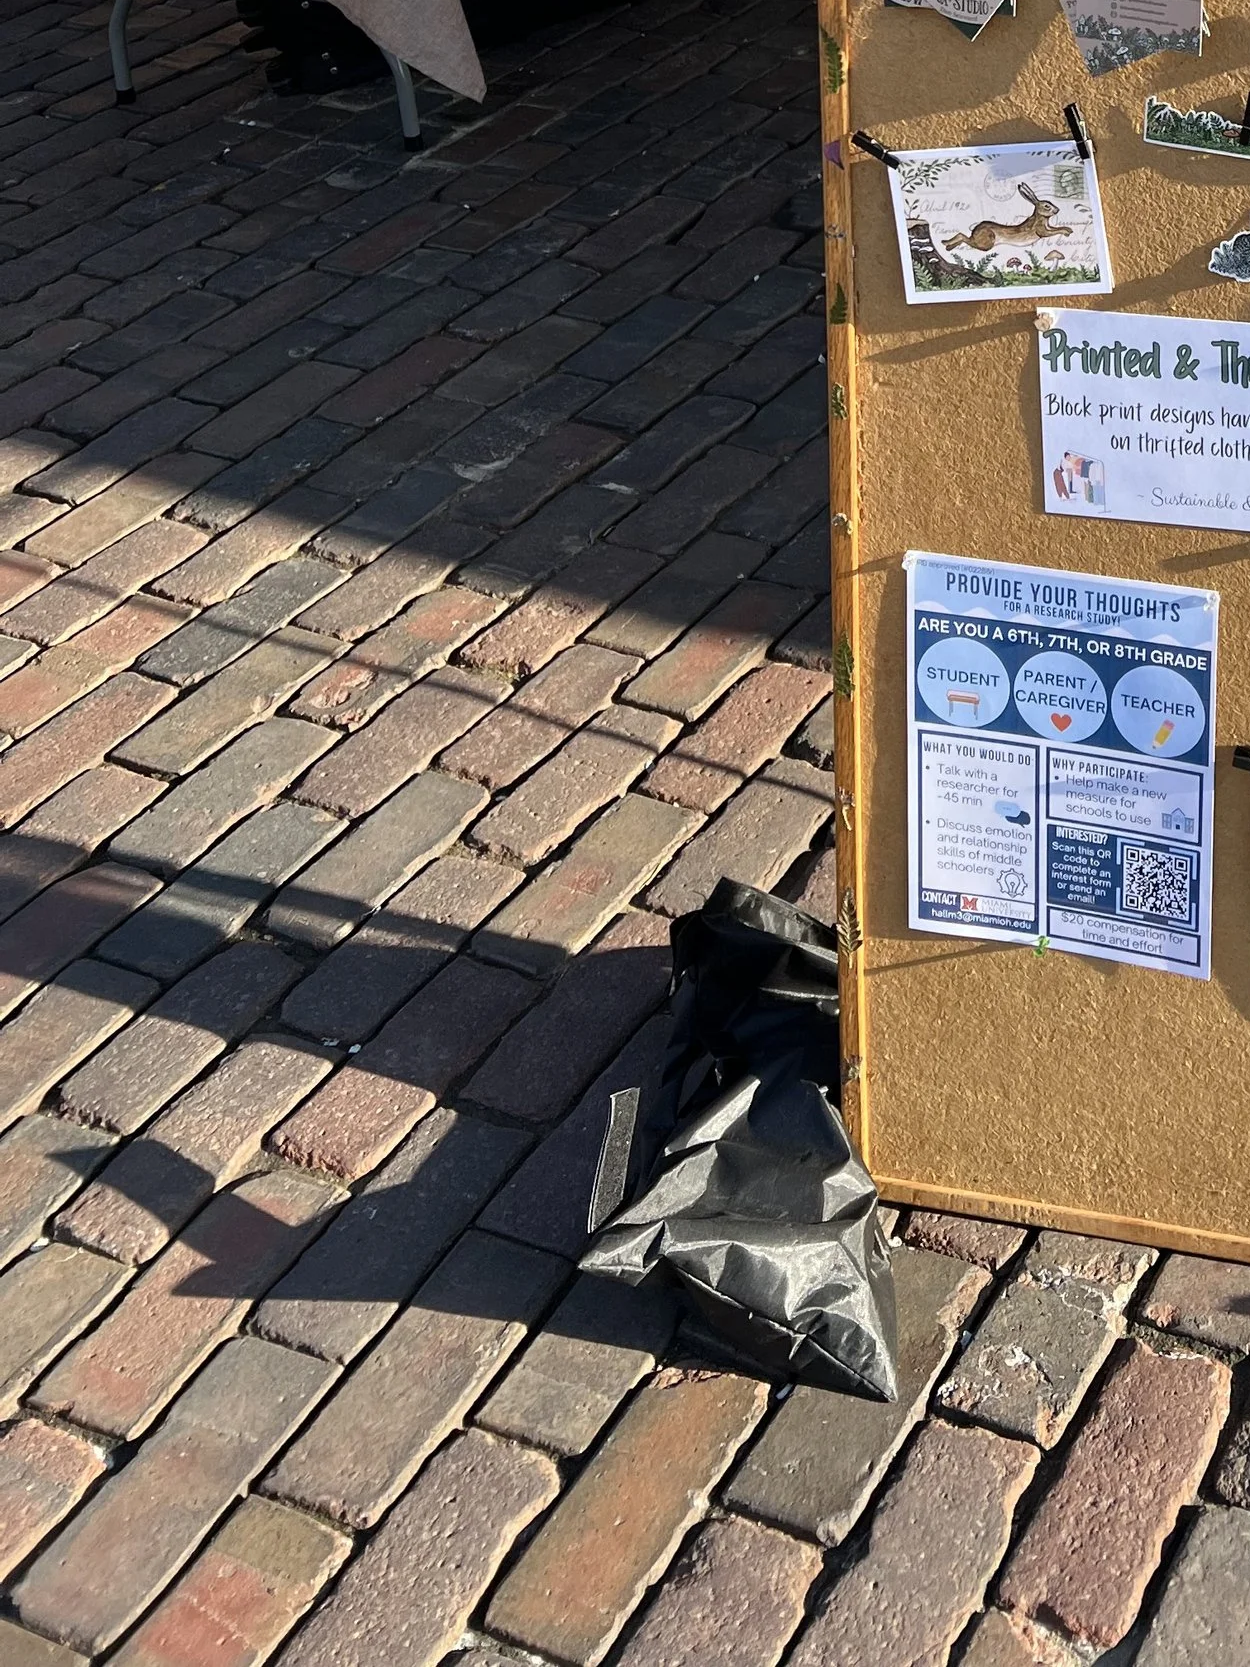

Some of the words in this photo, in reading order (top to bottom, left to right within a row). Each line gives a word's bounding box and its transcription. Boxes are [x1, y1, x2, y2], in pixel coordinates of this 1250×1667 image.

[1042, 327, 1162, 380] Printed
[1173, 343, 1201, 382] &
[1045, 392, 1092, 418] Block
[1099, 400, 1142, 426] print
[1150, 402, 1215, 434] designs
[1110, 434, 1130, 452] on
[1137, 432, 1204, 457] thrifted
[1151, 487, 1239, 512] Sustainable
[946, 572, 1022, 600] PROVIDE
[1030, 583, 1077, 608] YOUR
[1085, 591, 1181, 623] THOUGHTS
[1003, 600, 1021, 613] FOR
[1034, 604, 1083, 622] RESEARCH
[1087, 613, 1121, 627] STUDY!
[918, 617, 950, 634] ARE
[953, 621, 989, 639] YOU
[1007, 629, 1044, 648] 6TH,
[1048, 635, 1083, 654] 7TH,
[1086, 640, 1111, 656] OR
[1114, 644, 1147, 662] 8TH
[1150, 650, 1208, 671] GRADE
[926, 666, 1001, 688] STUDENT
[1023, 669, 1087, 691] PARENT
[1015, 688, 1106, 715] CAREGIVER
[1121, 693, 1196, 719] TEACHER
[923, 741, 953, 755] WHAT
[956, 745, 976, 758] YOU
[980, 748, 1014, 764] WOULD
[1052, 757, 1075, 772] WHY
[937, 763, 961, 776] Talk
[964, 768, 988, 780] with
[937, 778, 1000, 796] researcher
[1003, 786, 1019, 799] for
[937, 817, 983, 834] Discuss
[985, 827, 1033, 842] emotion
[1055, 825, 1108, 845] INTERESTED?
[921, 890, 958, 907] CONTACT
[1061, 911, 1085, 926] $20
[1086, 917, 1167, 942] compensation
[1168, 932, 1185, 945] for
[1082, 928, 1107, 943] time
[1109, 934, 1130, 948] and
[1132, 939, 1163, 954] effort
